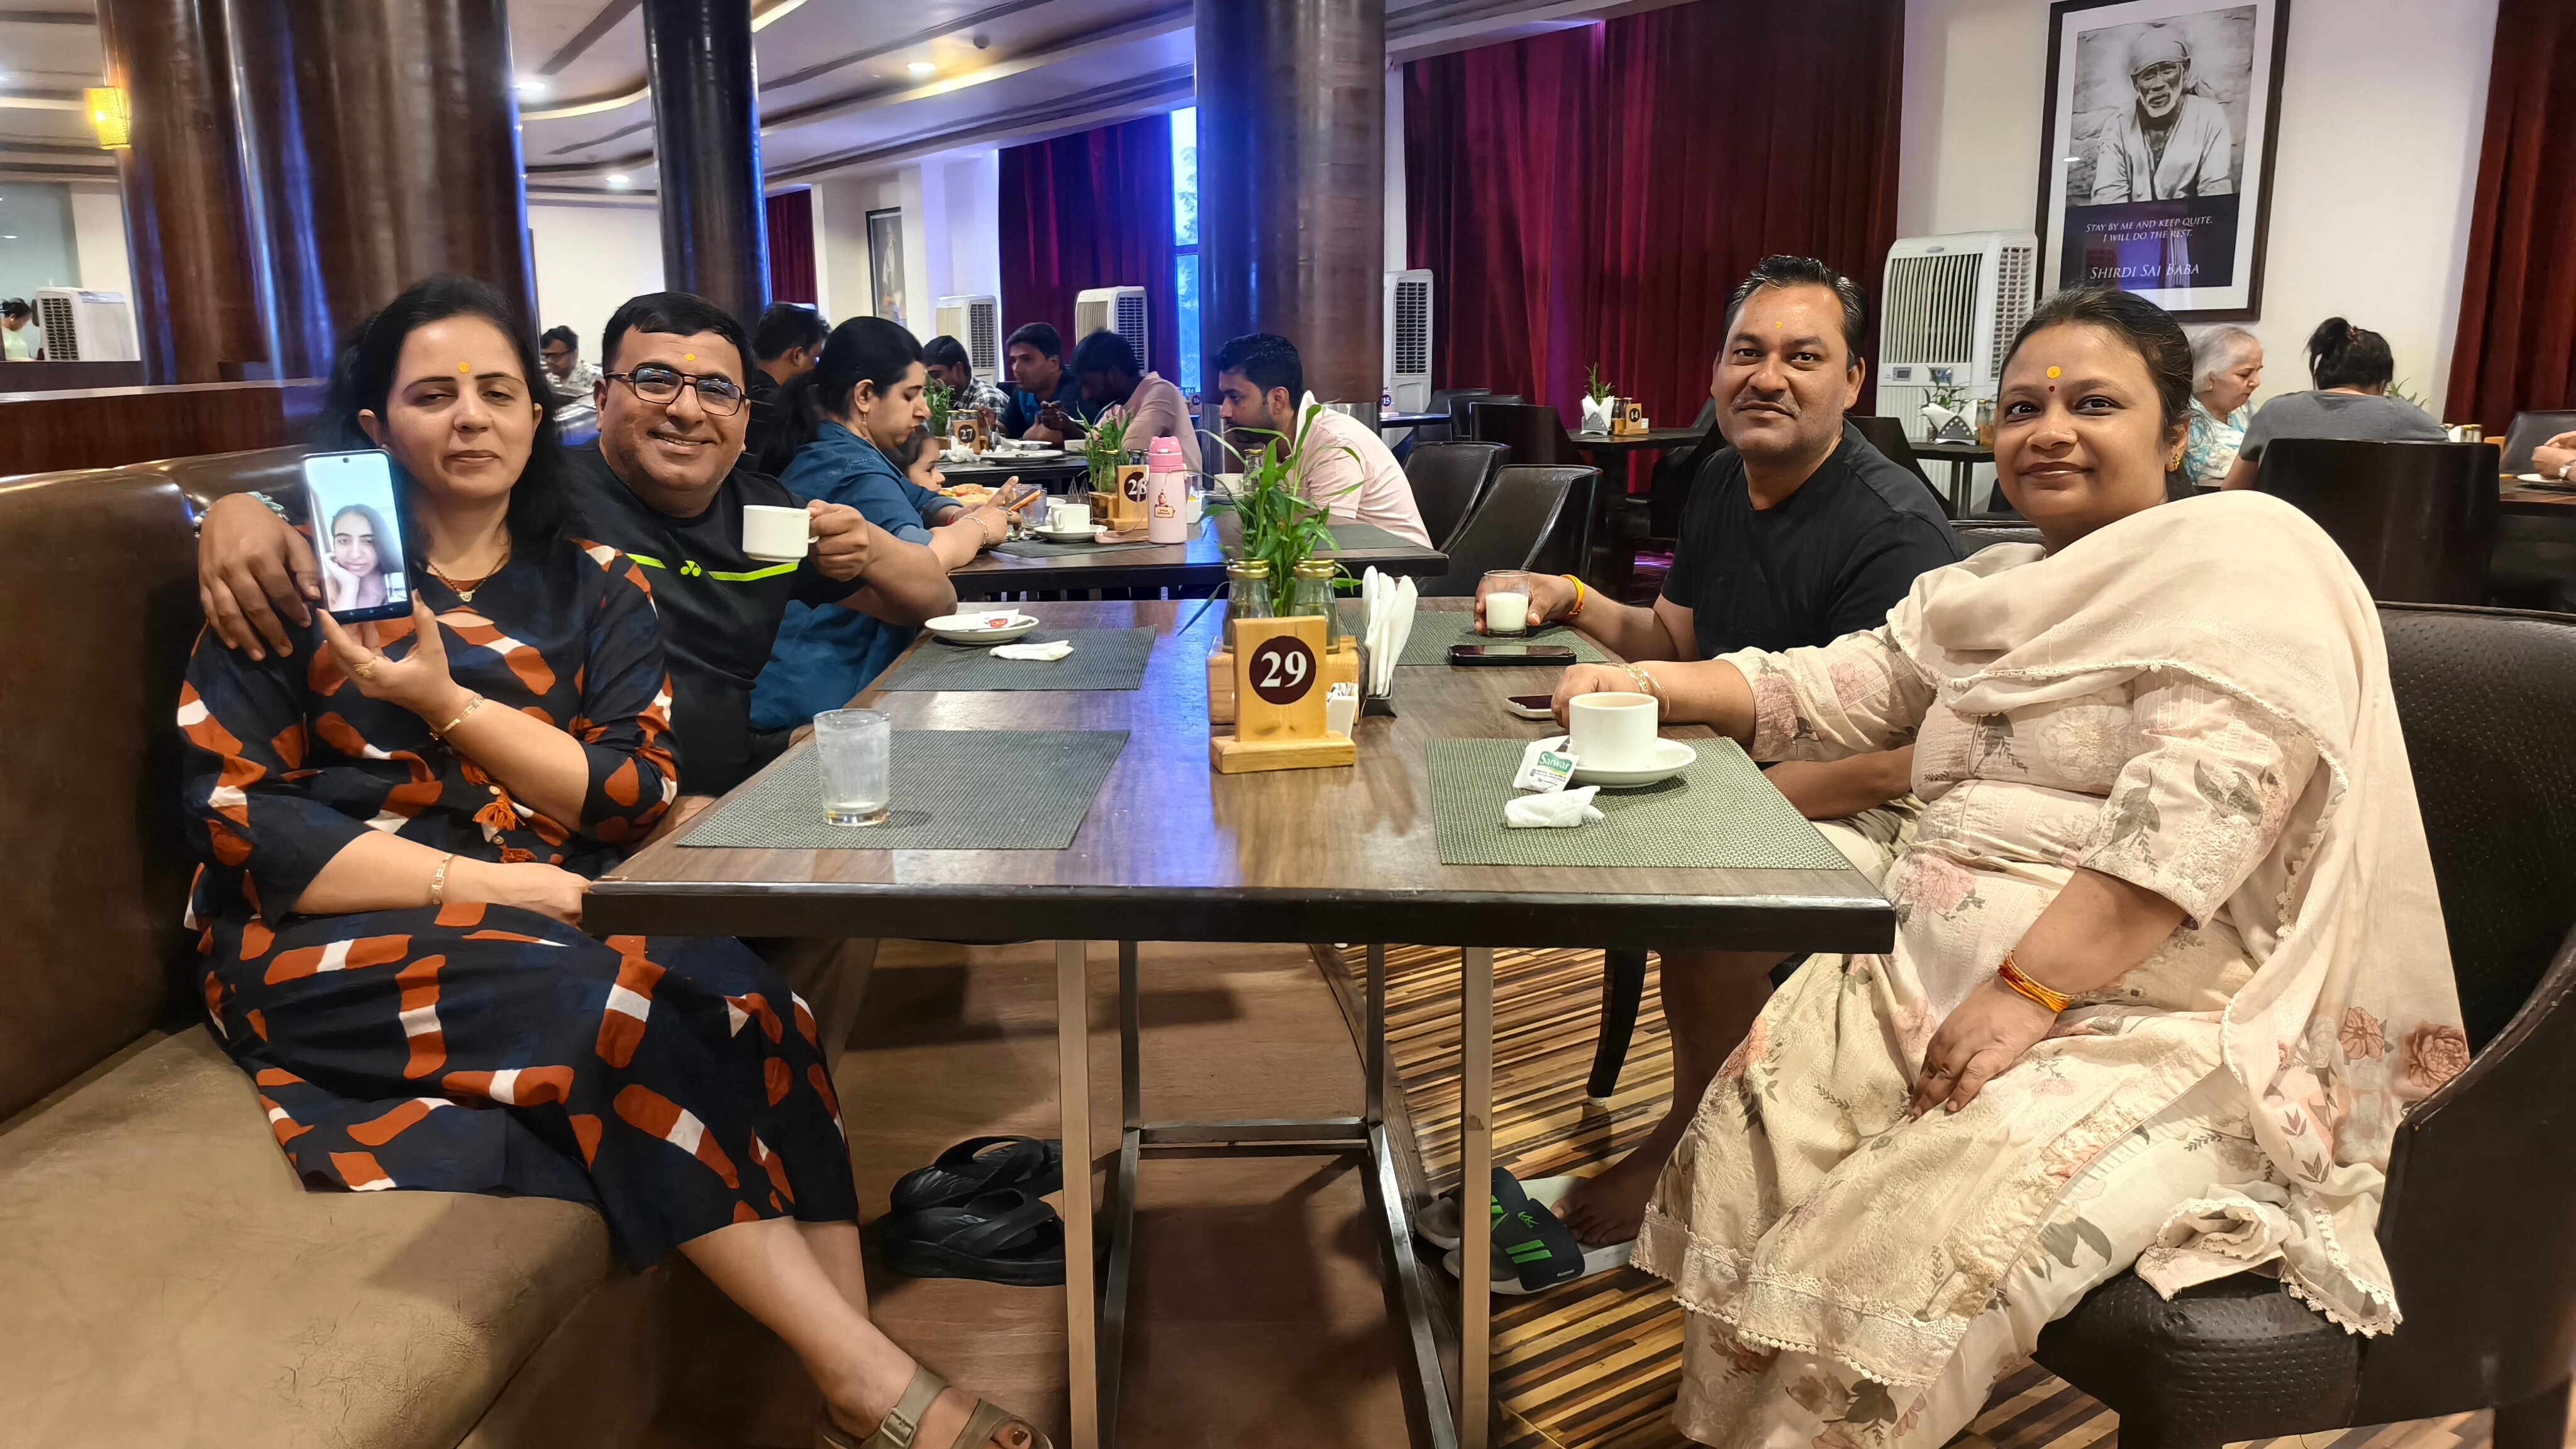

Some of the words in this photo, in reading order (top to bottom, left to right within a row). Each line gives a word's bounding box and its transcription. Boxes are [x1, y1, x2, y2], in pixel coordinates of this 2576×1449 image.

[2085, 224, 2106, 232] STAY
[2107, 223, 2119, 231] BY
[2120, 221, 2133, 230] ME
[2136, 219, 2156, 229] AND
[2158, 218, 2180, 227] KEEP
[2182, 216, 2212, 227] QUITE.
[2103, 233, 2107, 243] I
[2110, 233, 2129, 242] WILL
[2133, 231, 2147, 240] DO
[2150, 230, 2167, 239] THE
[2090, 267, 2136, 279] SHIRDI
[2140, 264, 2161, 277] SAI
[2167, 264, 2199, 275] BABA
[960, 428, 973, 440] 27
[1260, 651, 1307, 687] 29
